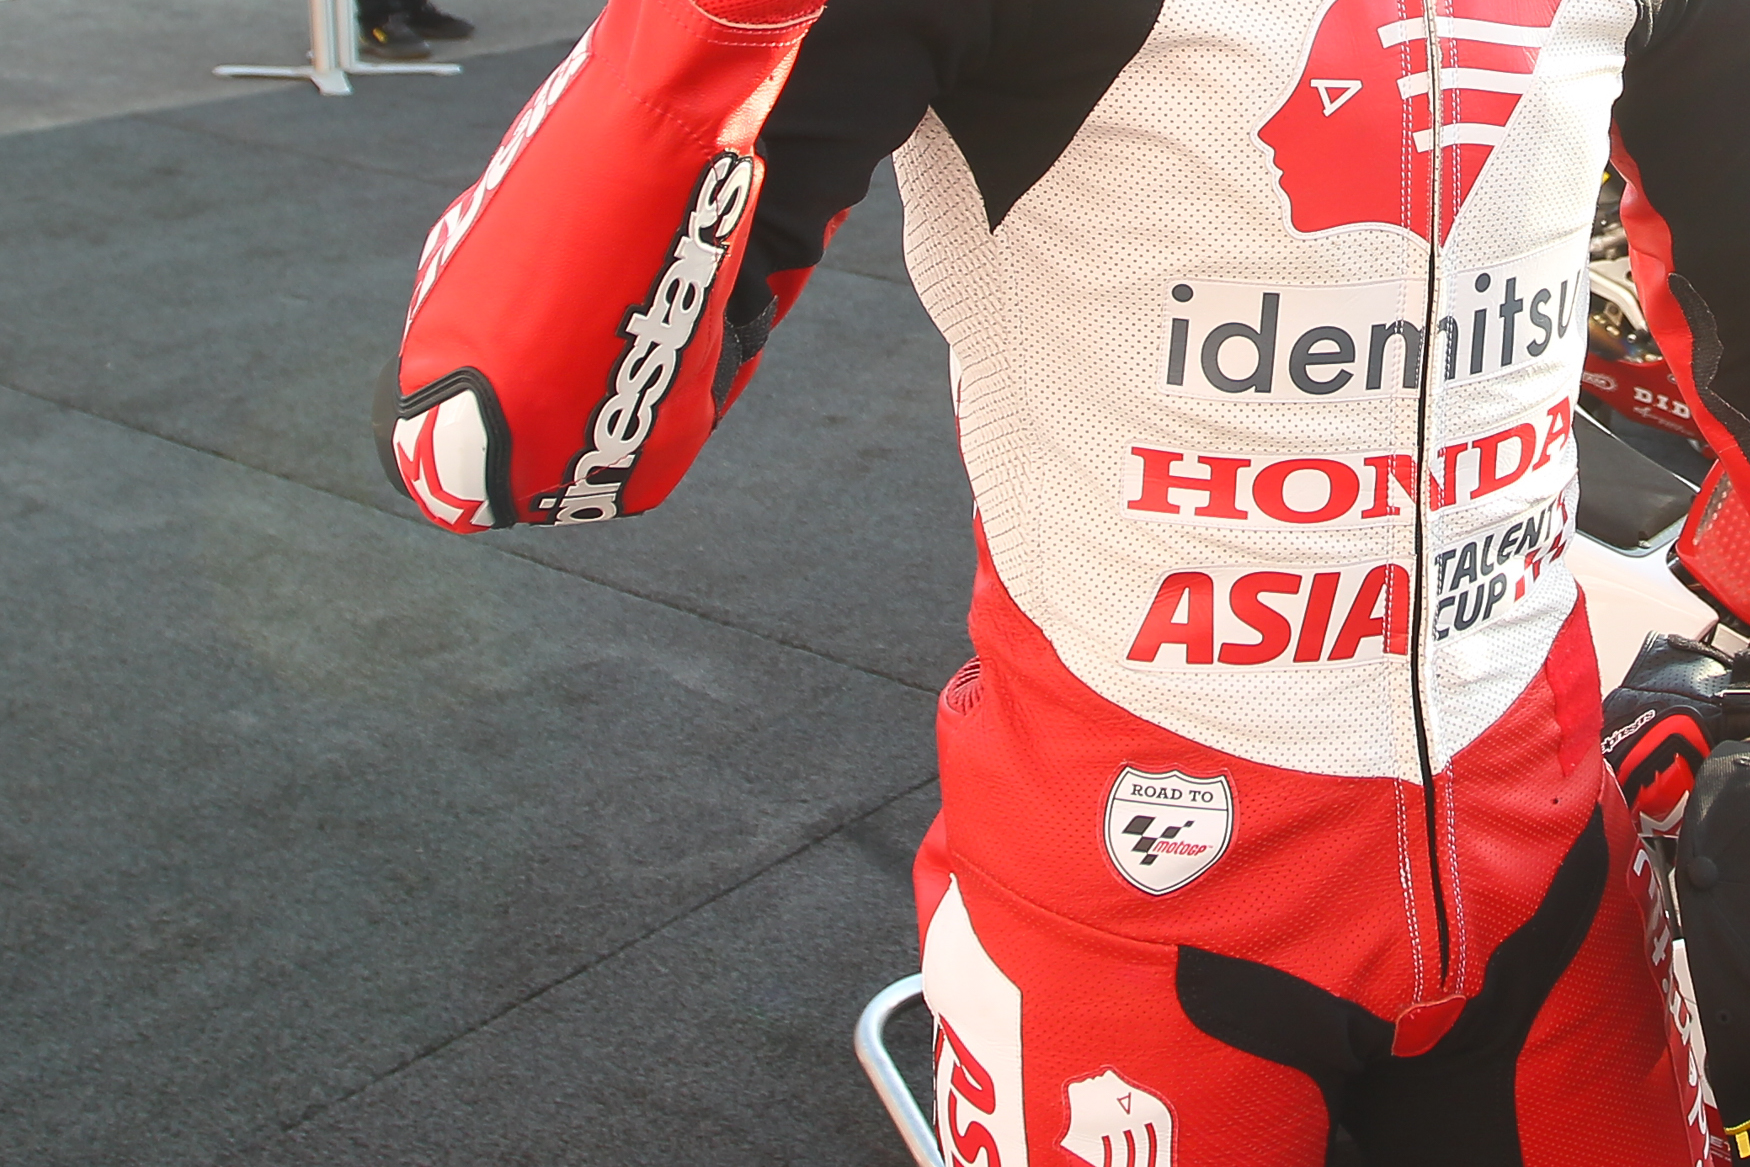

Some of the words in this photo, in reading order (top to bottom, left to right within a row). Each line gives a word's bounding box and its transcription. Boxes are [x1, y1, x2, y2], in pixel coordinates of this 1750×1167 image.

[1165, 267, 1583, 396] idemitsu
[1125, 395, 1573, 524] HONDA
[1125, 562, 1411, 666] ASIA
[1434, 498, 1558, 596] TALENT
[1433, 572, 1508, 641] CUP
[1130, 783, 1183, 801] ROAD
[1188, 789, 1215, 803] TO
